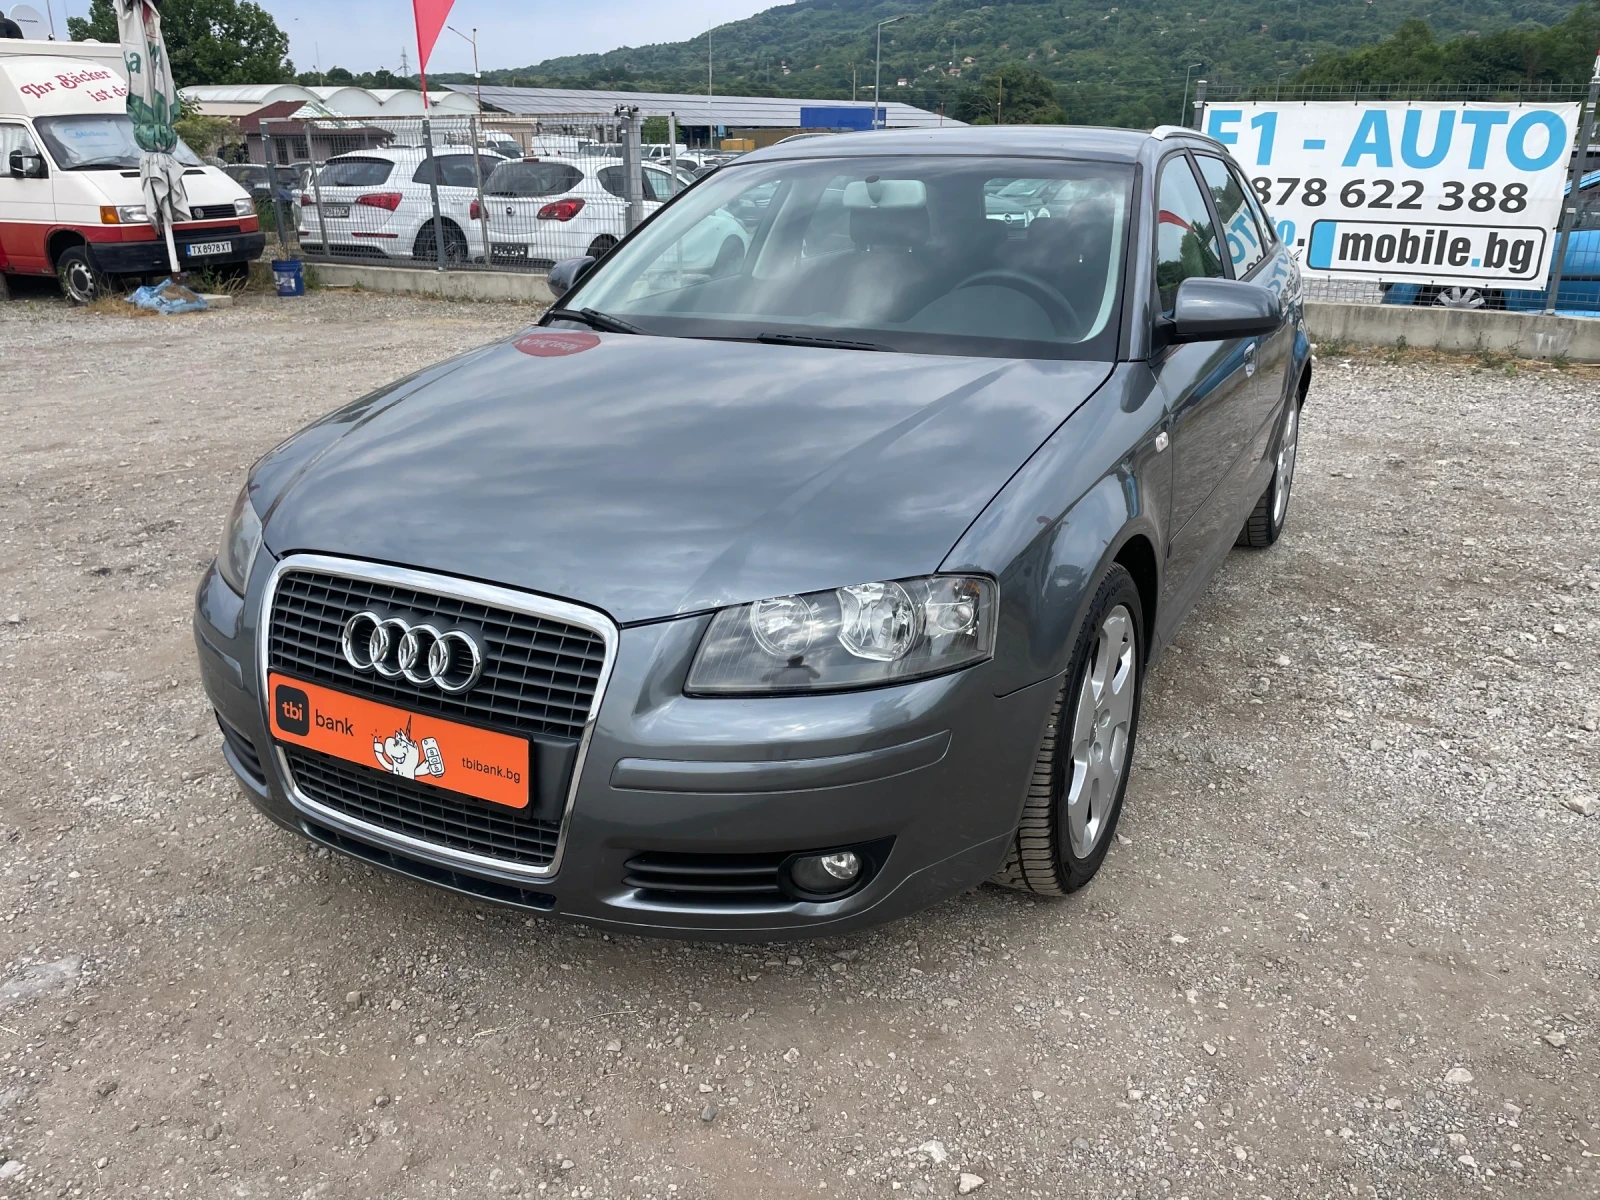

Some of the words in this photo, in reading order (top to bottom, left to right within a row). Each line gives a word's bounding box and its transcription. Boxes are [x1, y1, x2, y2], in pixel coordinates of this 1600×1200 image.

[20, 82, 55, 99] Ihr
[55, 69, 111, 89] Bäcker
[87, 89, 113, 102] ist
[1341, 110, 1567, 172] AUTO
[1340, 179, 1424, 209] 622
[1437, 181, 1528, 213] 388
[1338, 228, 1535, 274] mobile.bg
[282, 701, 303, 721] tbi
[315, 709, 354, 737] bank
[461, 757, 521, 784] tbibank.bg
